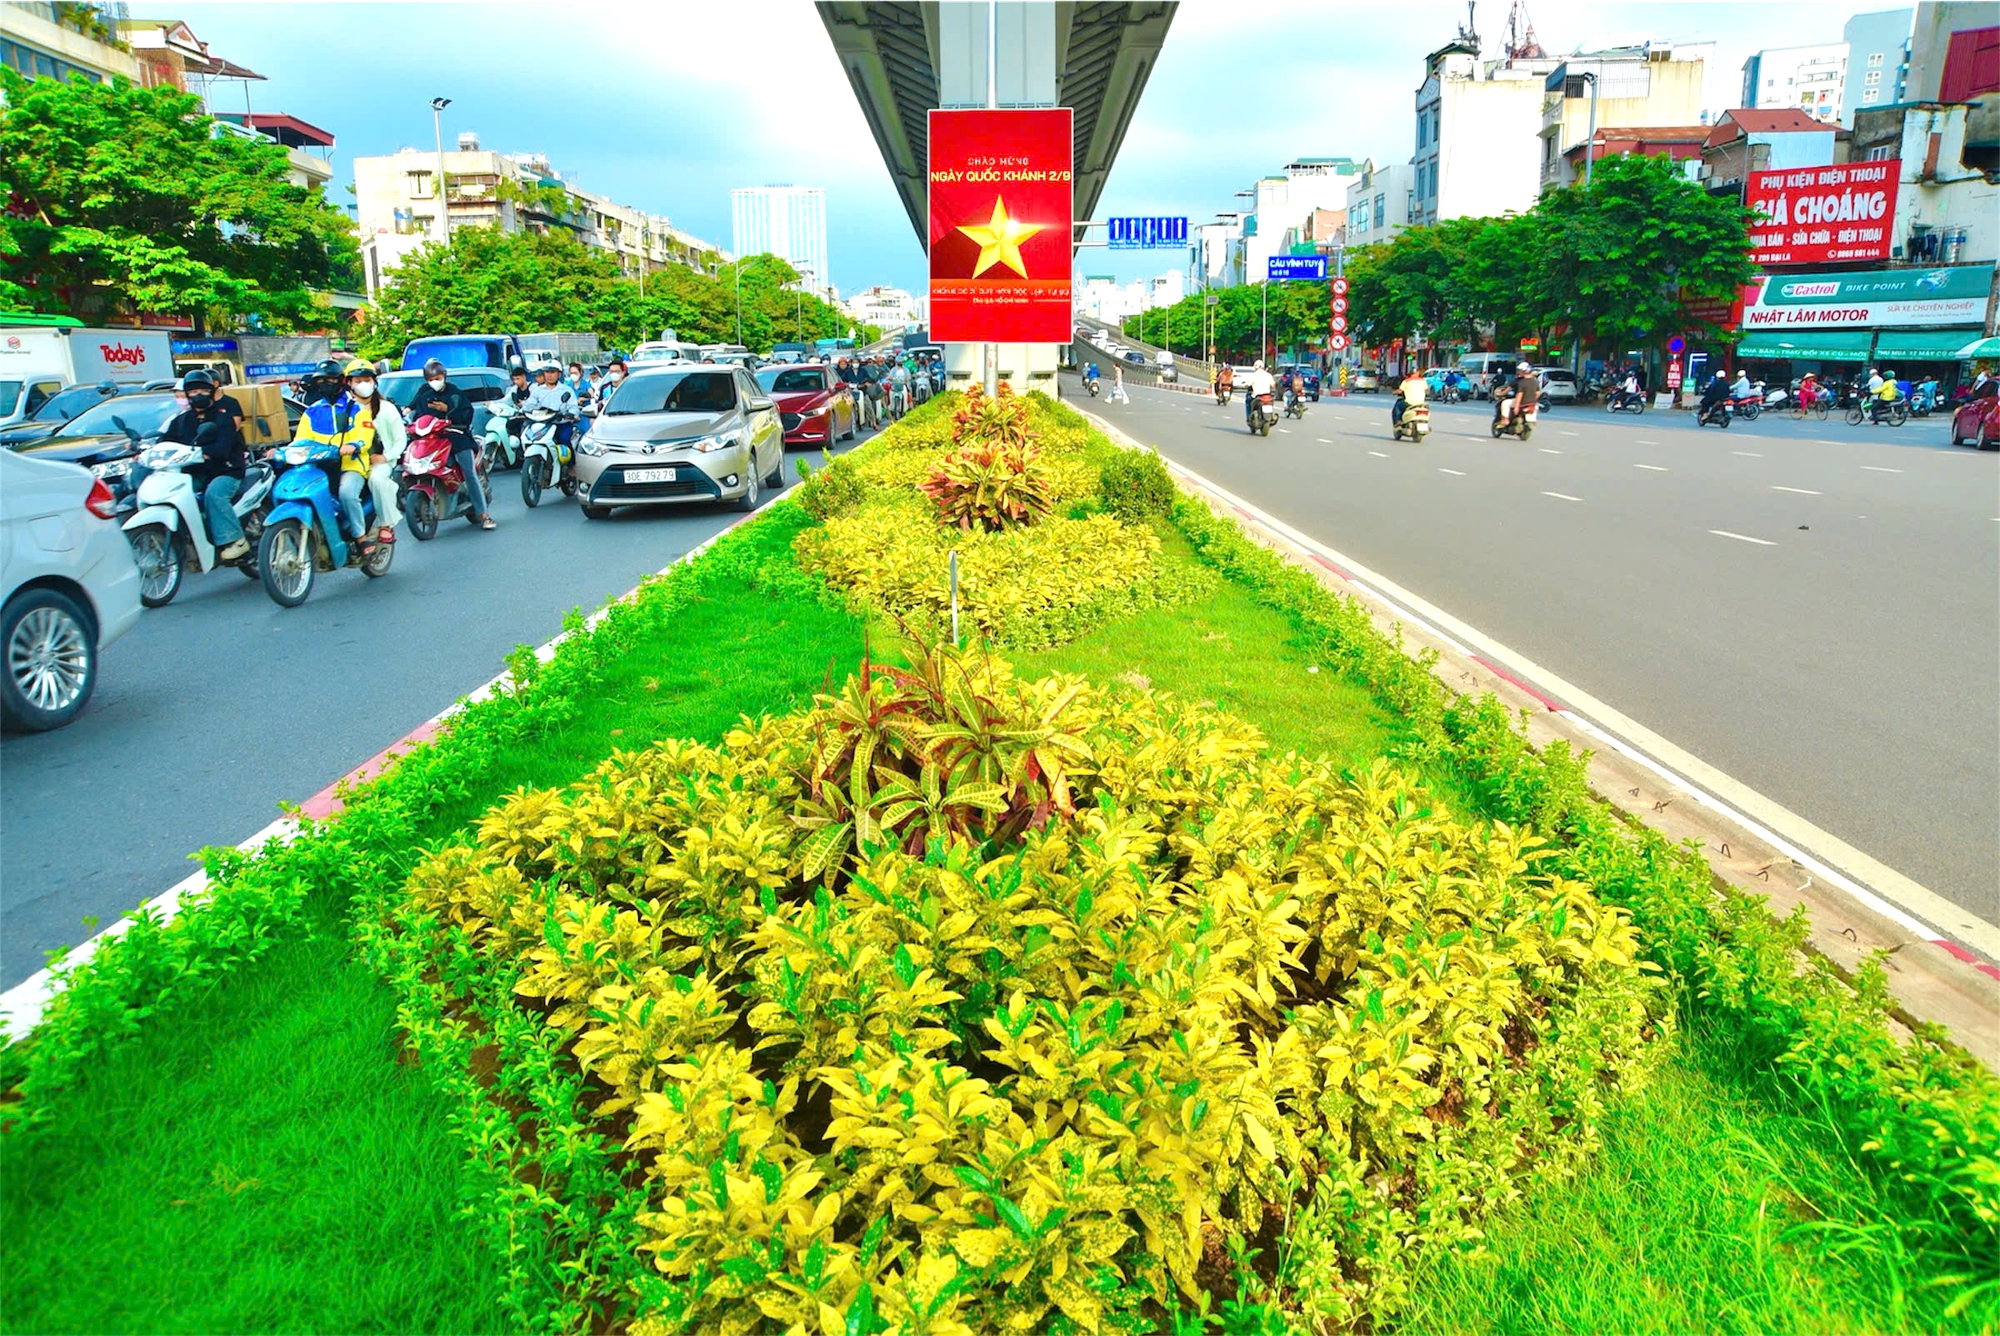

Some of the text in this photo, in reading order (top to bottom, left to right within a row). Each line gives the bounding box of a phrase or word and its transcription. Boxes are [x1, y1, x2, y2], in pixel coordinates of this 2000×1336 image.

[931, 167, 1071, 182] NGÀY QUỐC KHÁNH 2/9
[1760, 167, 1887, 190] PHỤ KIỆN ĐIỆN THOẠI
[1752, 188, 1887, 227] GIÁ CHOÁNG
[1767, 232, 1784, 246] BÁN
[1838, 227, 1857, 245] ĐIỆN
[1858, 228, 1883, 243] THOẠI
[1794, 283, 1837, 296] Castrol
[1845, 282, 1906, 292] BIKE POINT
[1750, 309, 1868, 326] NHẬT LÂM MOTOR
[100, 342, 145, 365] Today's
